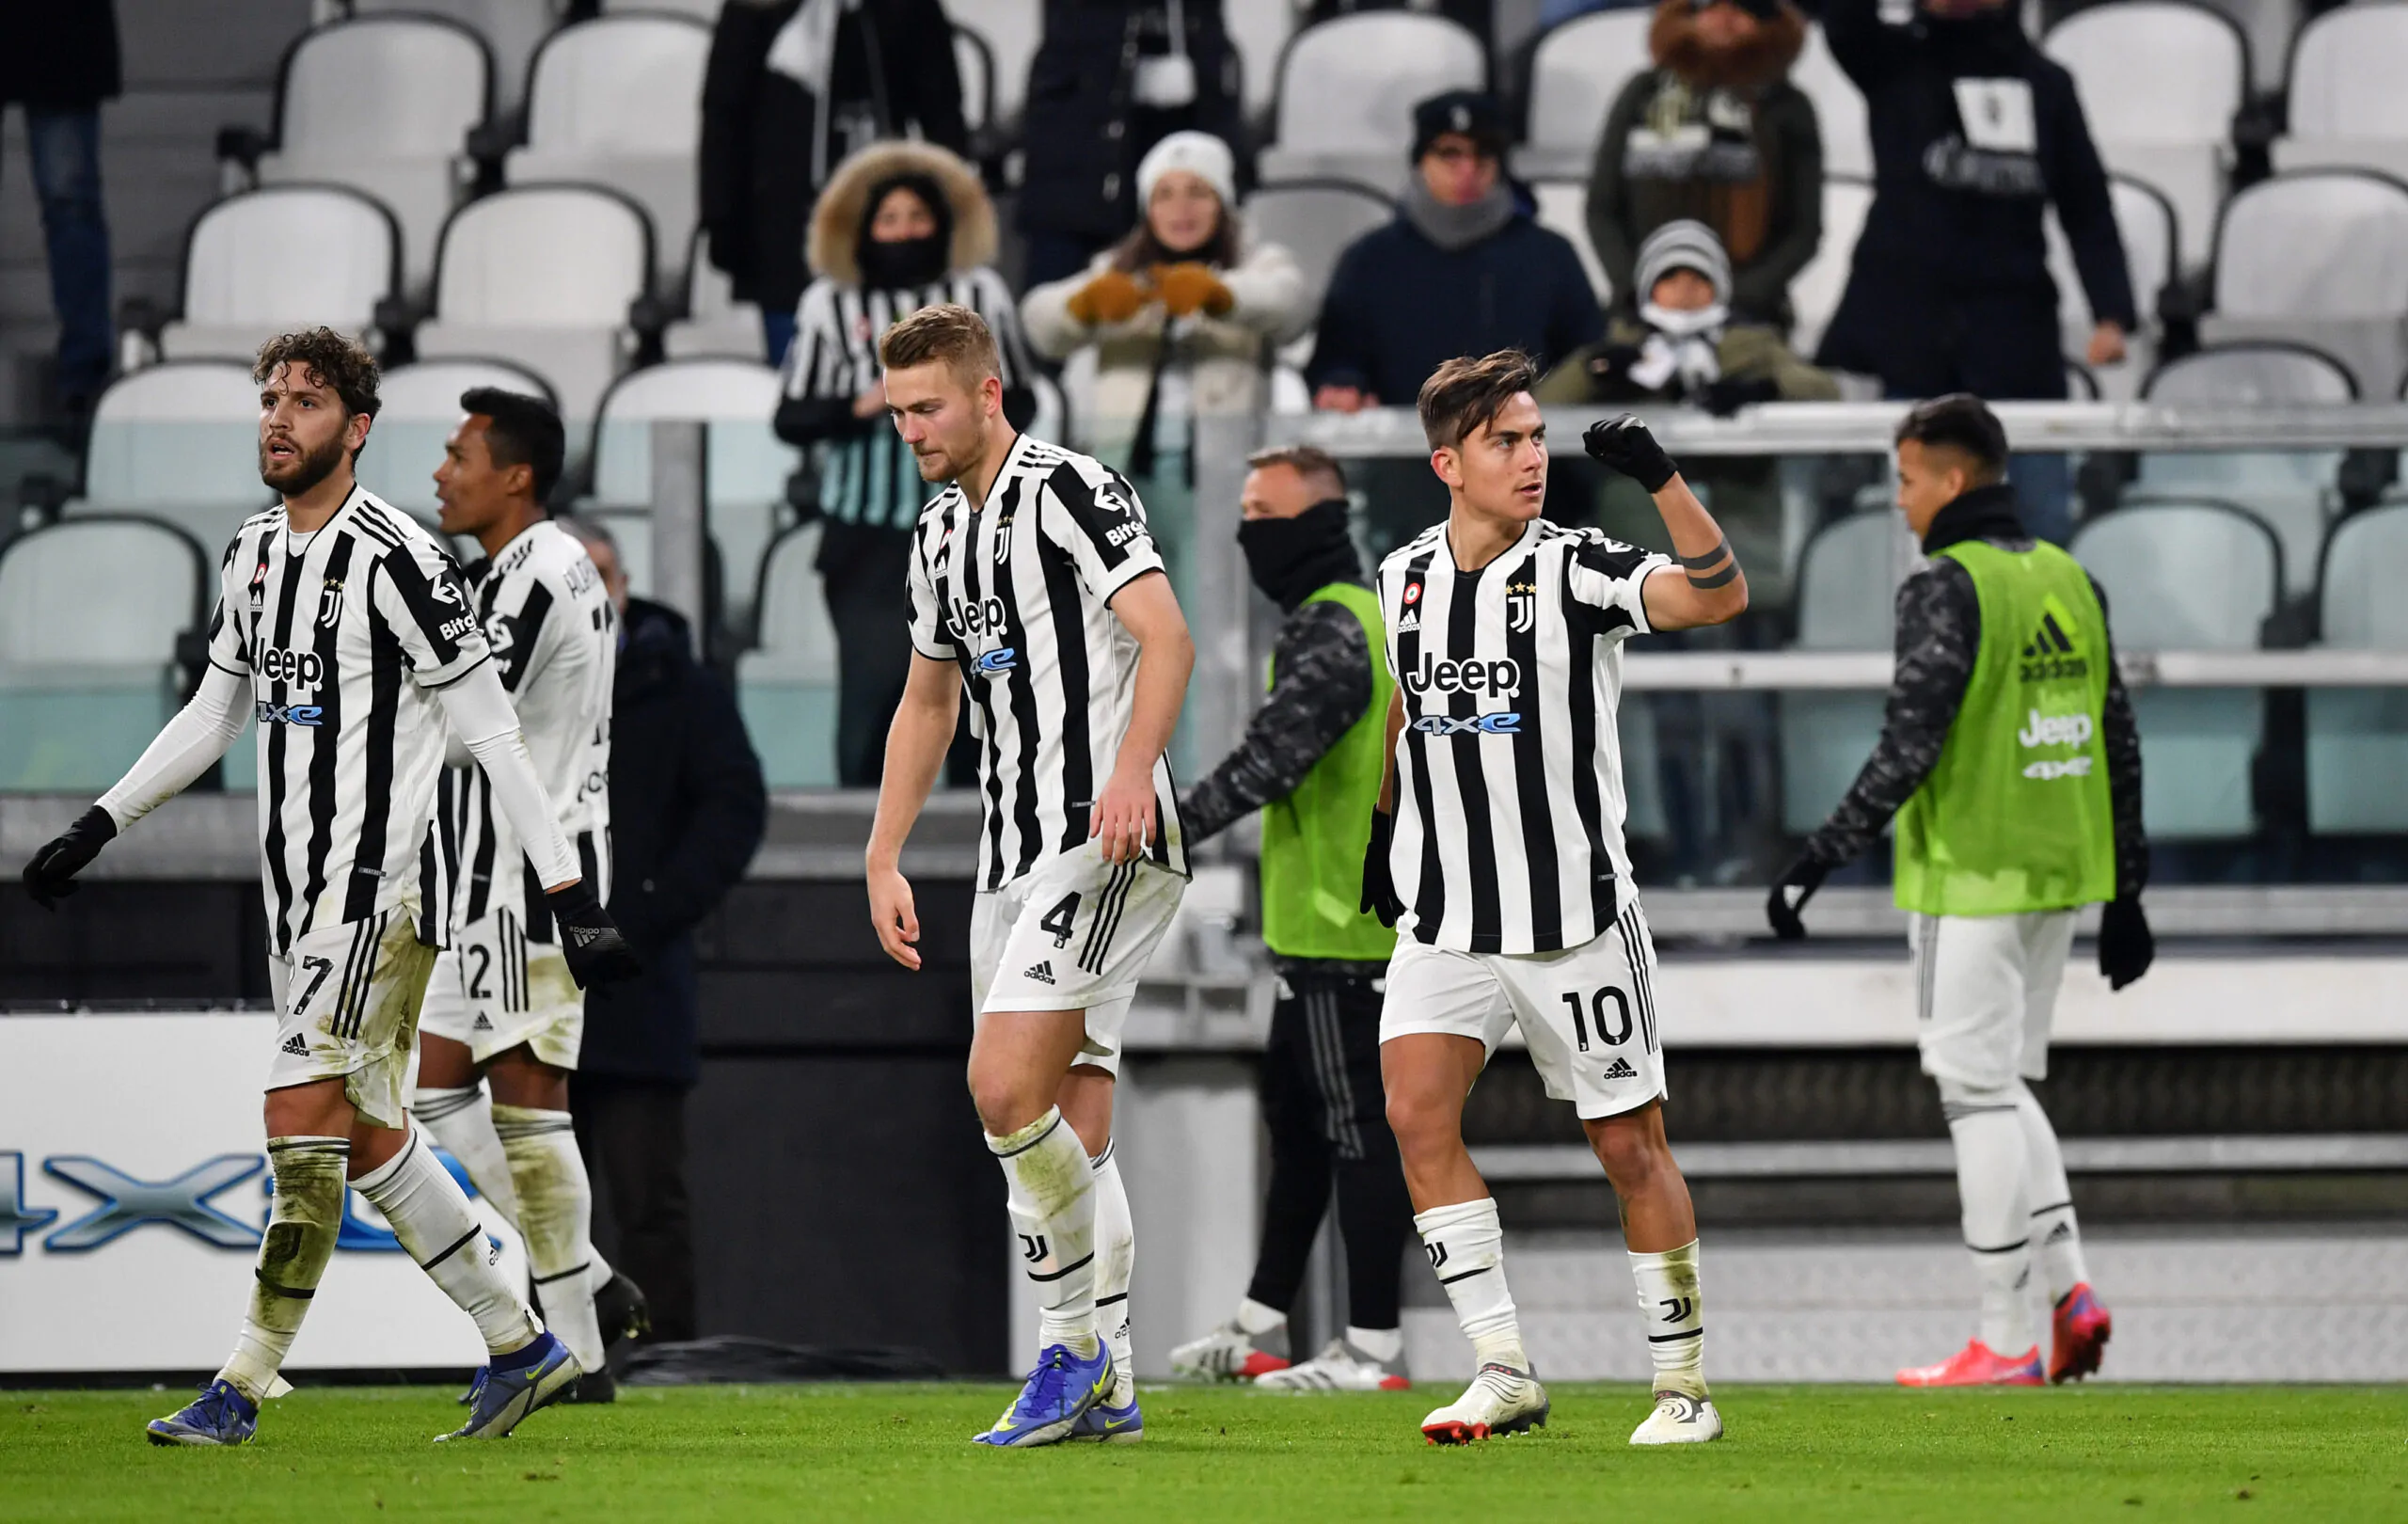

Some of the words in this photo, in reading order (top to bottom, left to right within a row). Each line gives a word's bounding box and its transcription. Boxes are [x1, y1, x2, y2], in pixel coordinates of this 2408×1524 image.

[945, 595, 1007, 639] Jeep
[255, 637, 323, 691] Jeep
[1406, 651, 1521, 699] Jeep
[1040, 891, 1082, 949] 4
[293, 955, 335, 1016] 7
[1023, 970, 1056, 986] adidas
[1561, 985, 1633, 1053] 10
[282, 1044, 310, 1057] adidas
[1603, 1070, 1638, 1080] adidas
